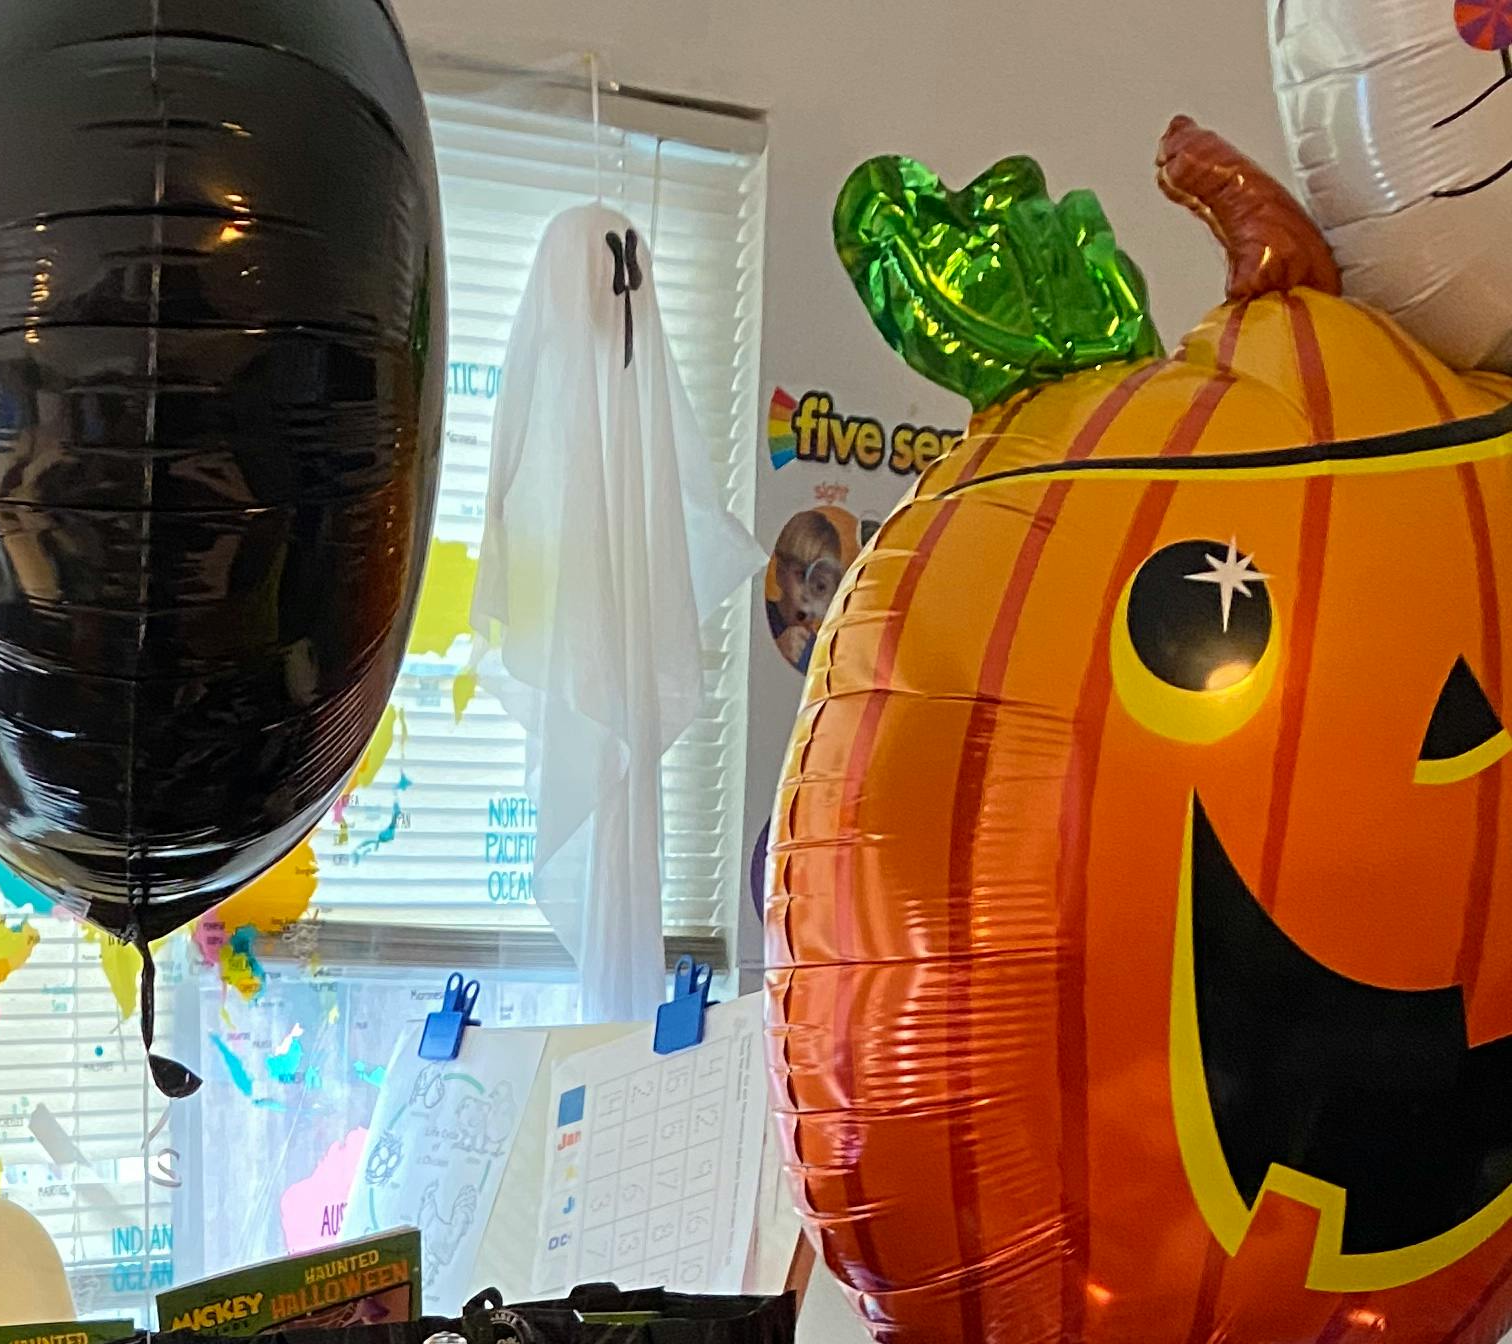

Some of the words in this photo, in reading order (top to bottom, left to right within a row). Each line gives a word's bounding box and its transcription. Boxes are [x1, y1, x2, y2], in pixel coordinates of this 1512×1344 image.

[448, 362, 479, 396] TIC
[792, 390, 884, 470] five
[489, 798, 537, 828] NORTH
[112, 1222, 174, 1256] INDAN
[305, 1249, 380, 1284] HAUNTED
[272, 1260, 409, 1319] HALLOWEEN
[171, 1292, 264, 1331] MICKEY
